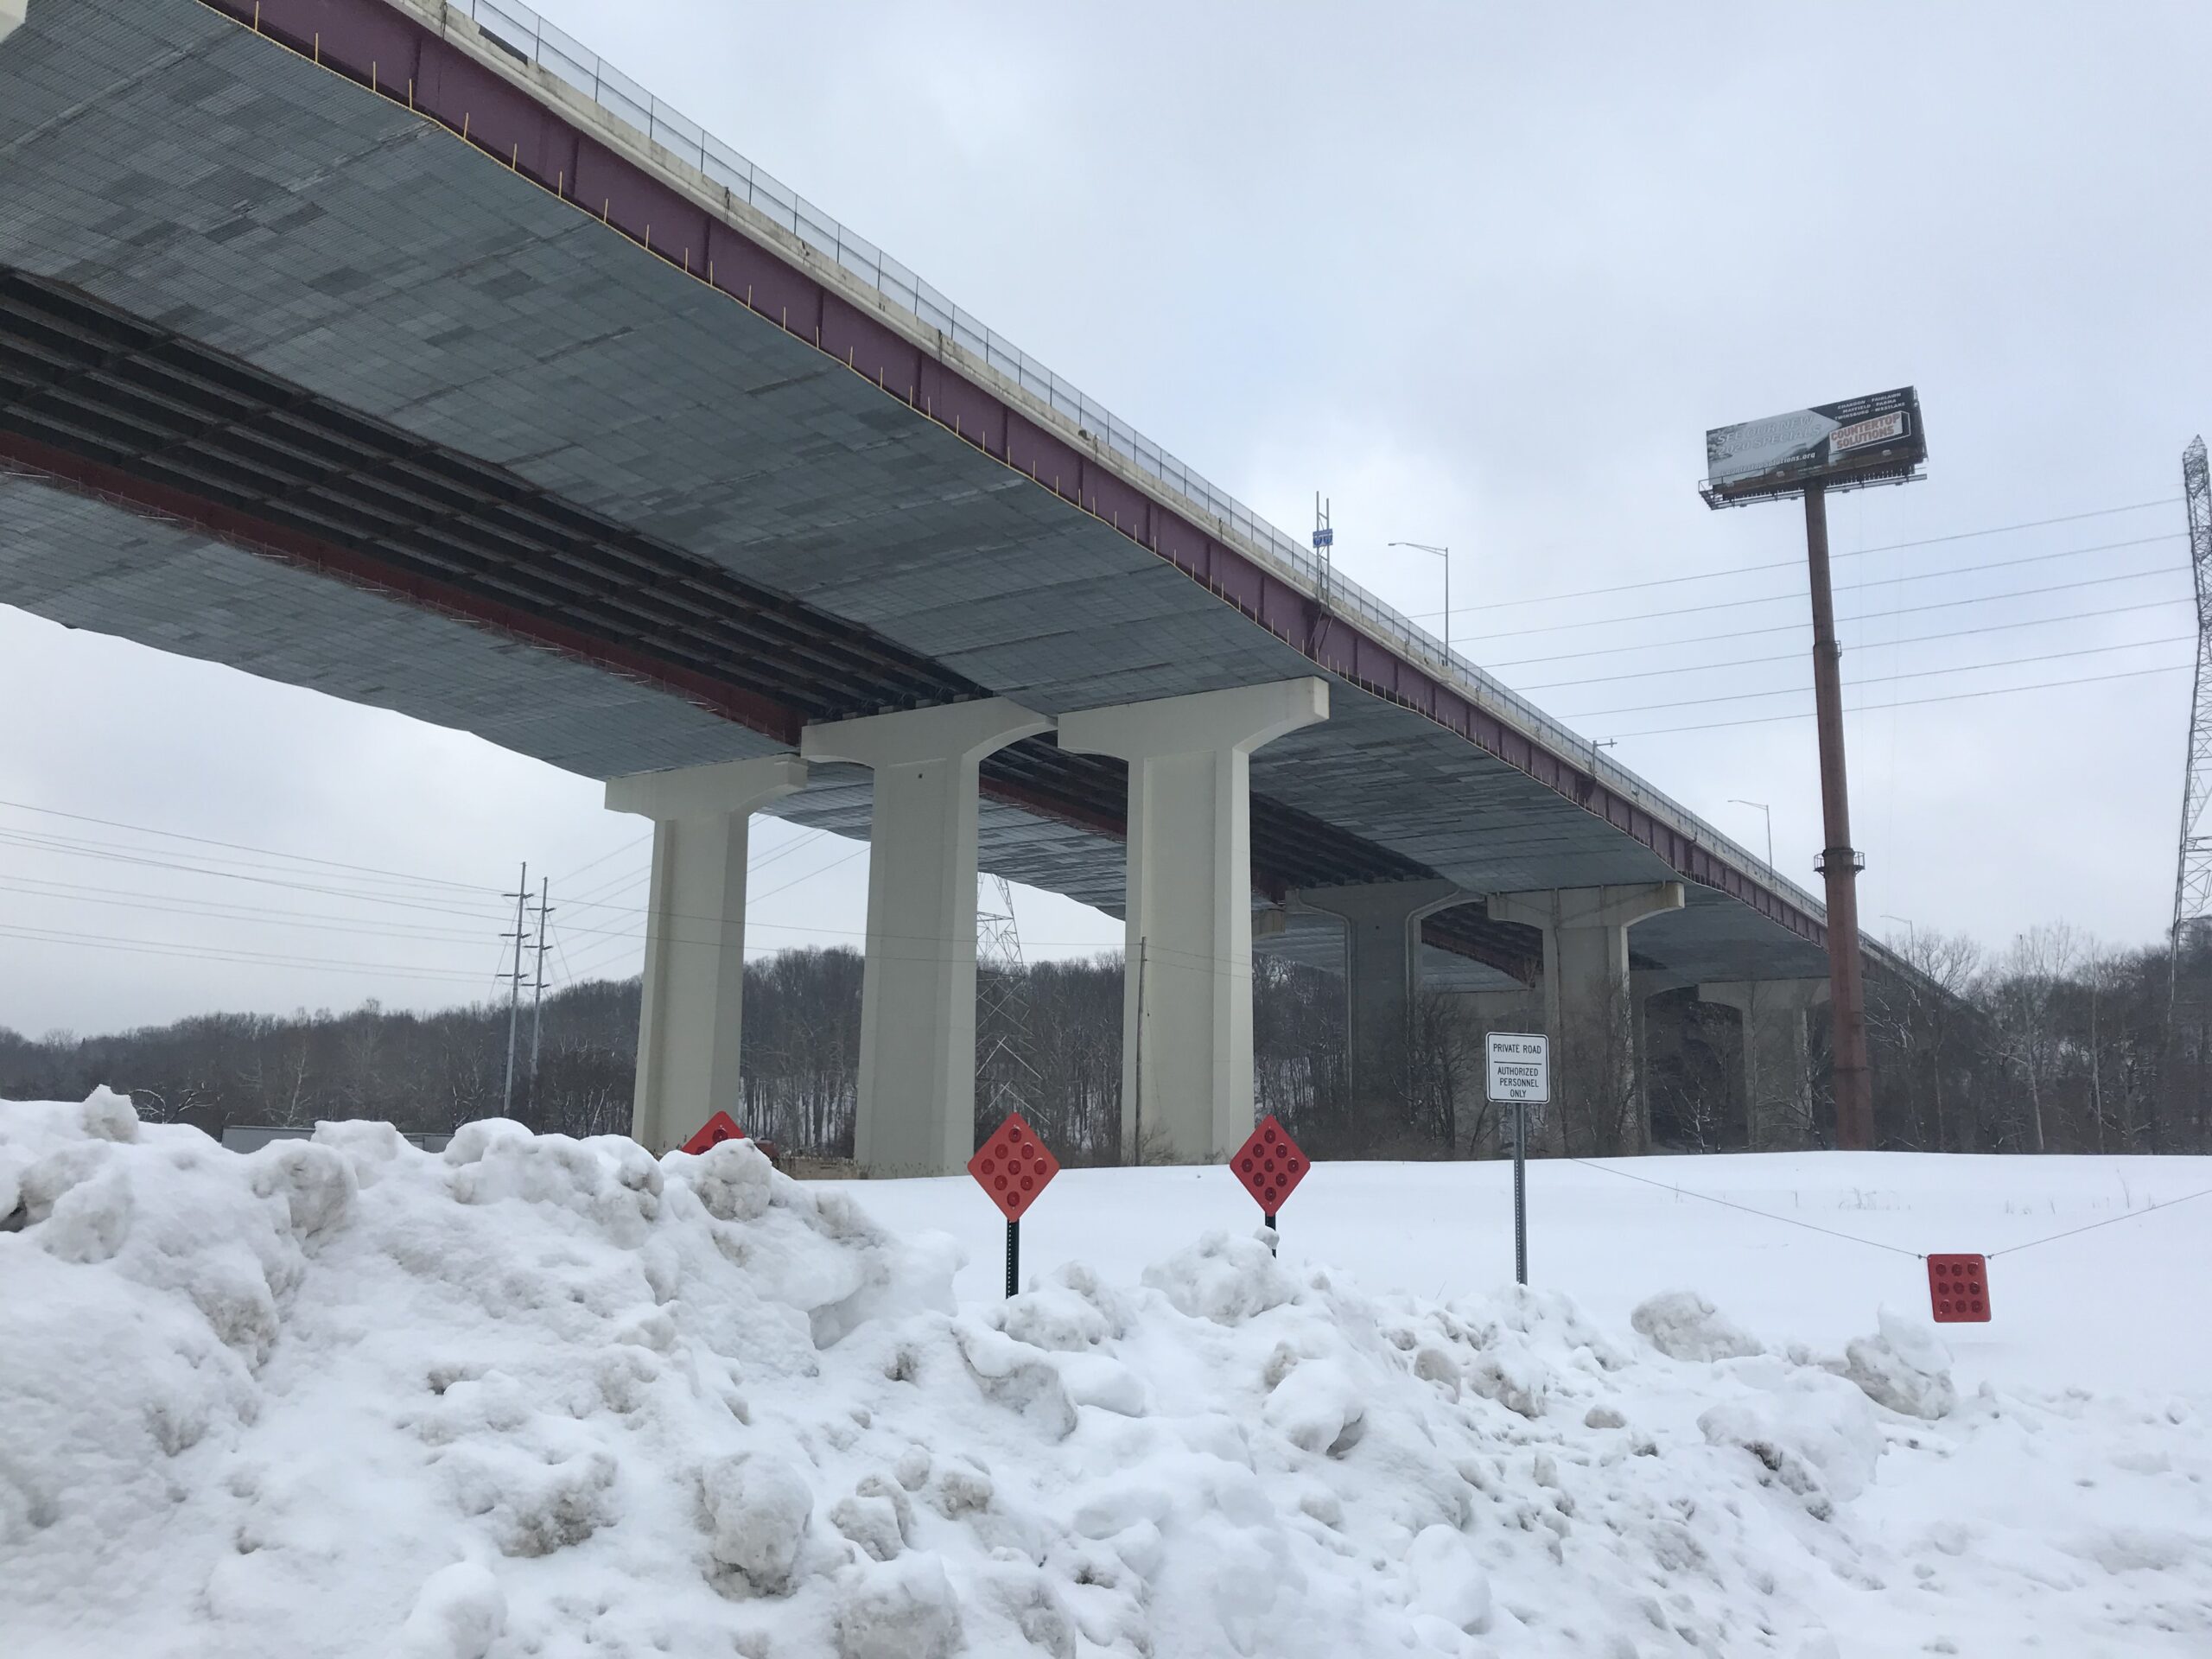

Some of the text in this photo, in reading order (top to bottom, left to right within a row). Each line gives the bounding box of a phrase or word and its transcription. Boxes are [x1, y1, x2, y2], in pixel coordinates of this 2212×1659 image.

[1837, 392, 1902, 410] CHARDON FAIRLAWN
[1842, 398, 1897, 413] MAYFIELD PARMA
[1834, 402, 1905, 421] TWINSBURG WESTLAKE
[1716, 415, 1814, 444] SEE OUR NEW
[1830, 413, 1901, 441] COUNTERTOP
[1718, 427, 1821, 455] 2020 SPECIALS
[1836, 426, 1895, 448] SOLUTIONS
[1493, 1043, 1541, 1054] PRIVATE ROAD
[1497, 1066, 1539, 1077] AUTHORIZED
[1499, 1077, 1539, 1087] PERSONNEL
[1510, 1089, 1527, 1098] ONLY
